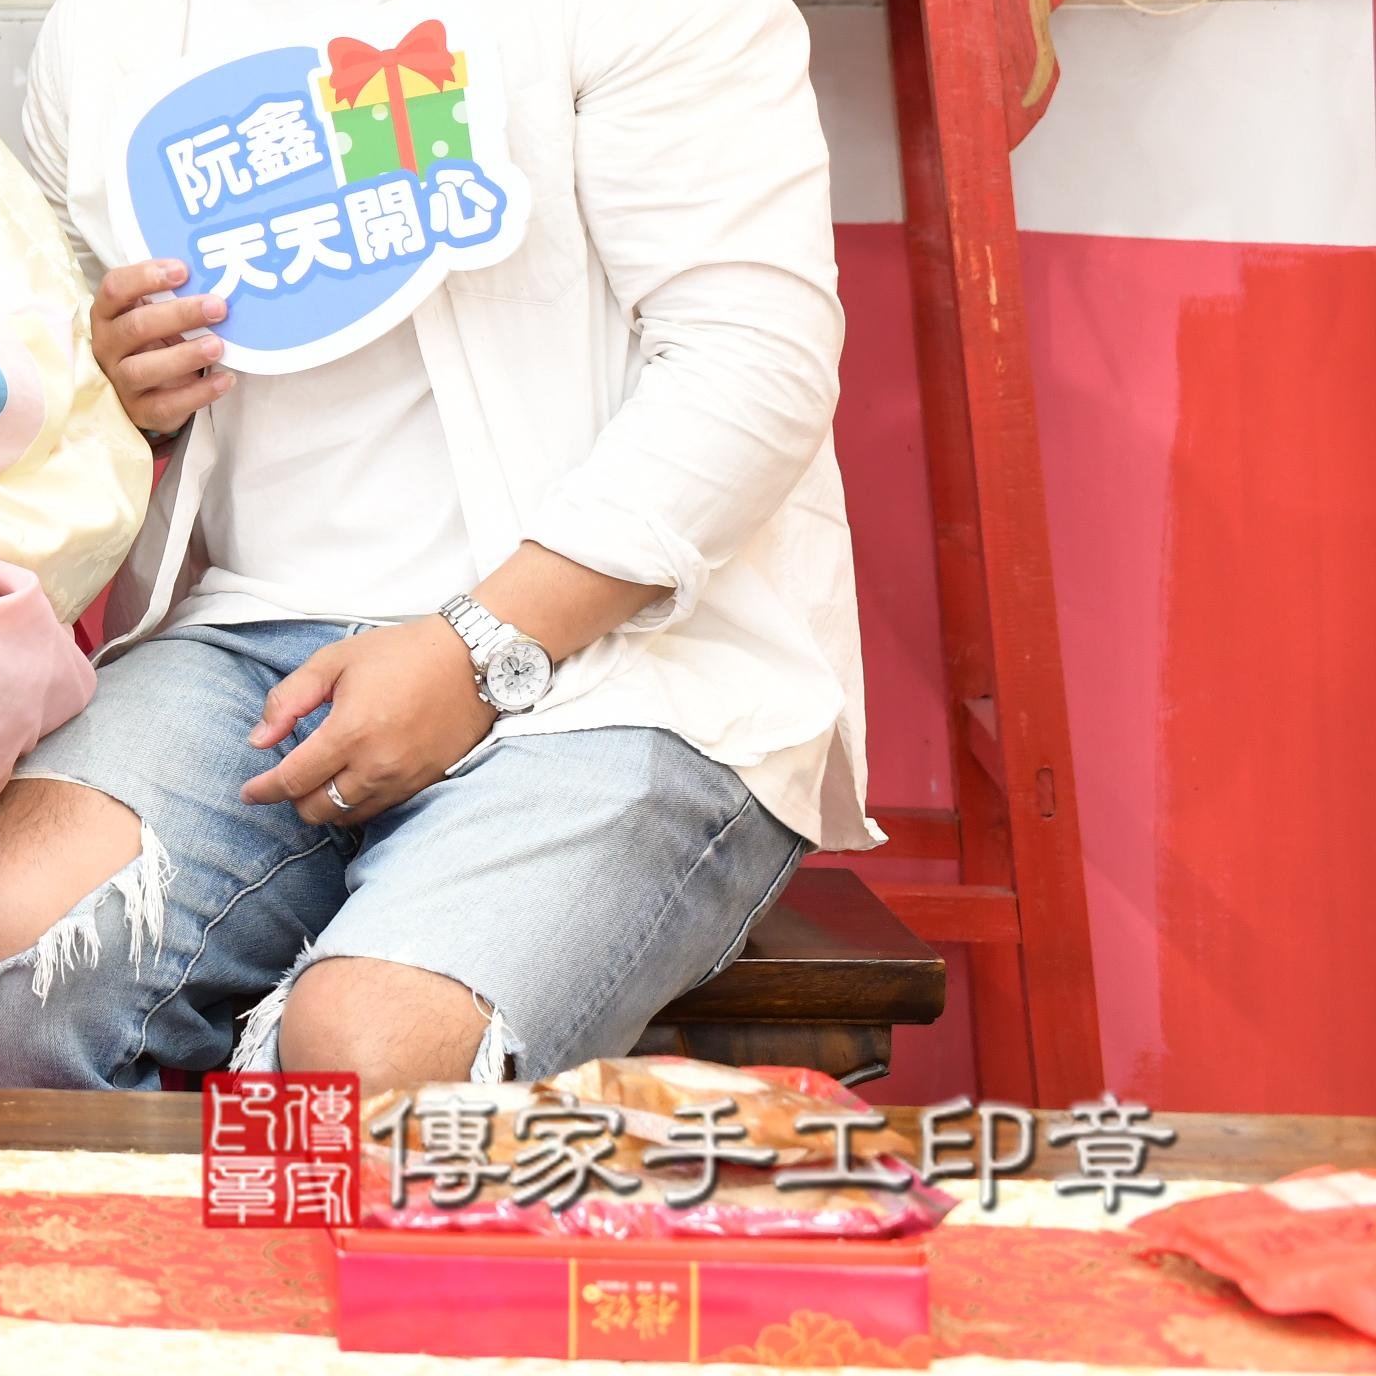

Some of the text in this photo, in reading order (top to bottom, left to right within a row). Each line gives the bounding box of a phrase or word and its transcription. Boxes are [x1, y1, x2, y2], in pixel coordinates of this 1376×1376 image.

[165, 99, 324, 216] 阮鑫
[196, 169, 498, 302] 天天開心
